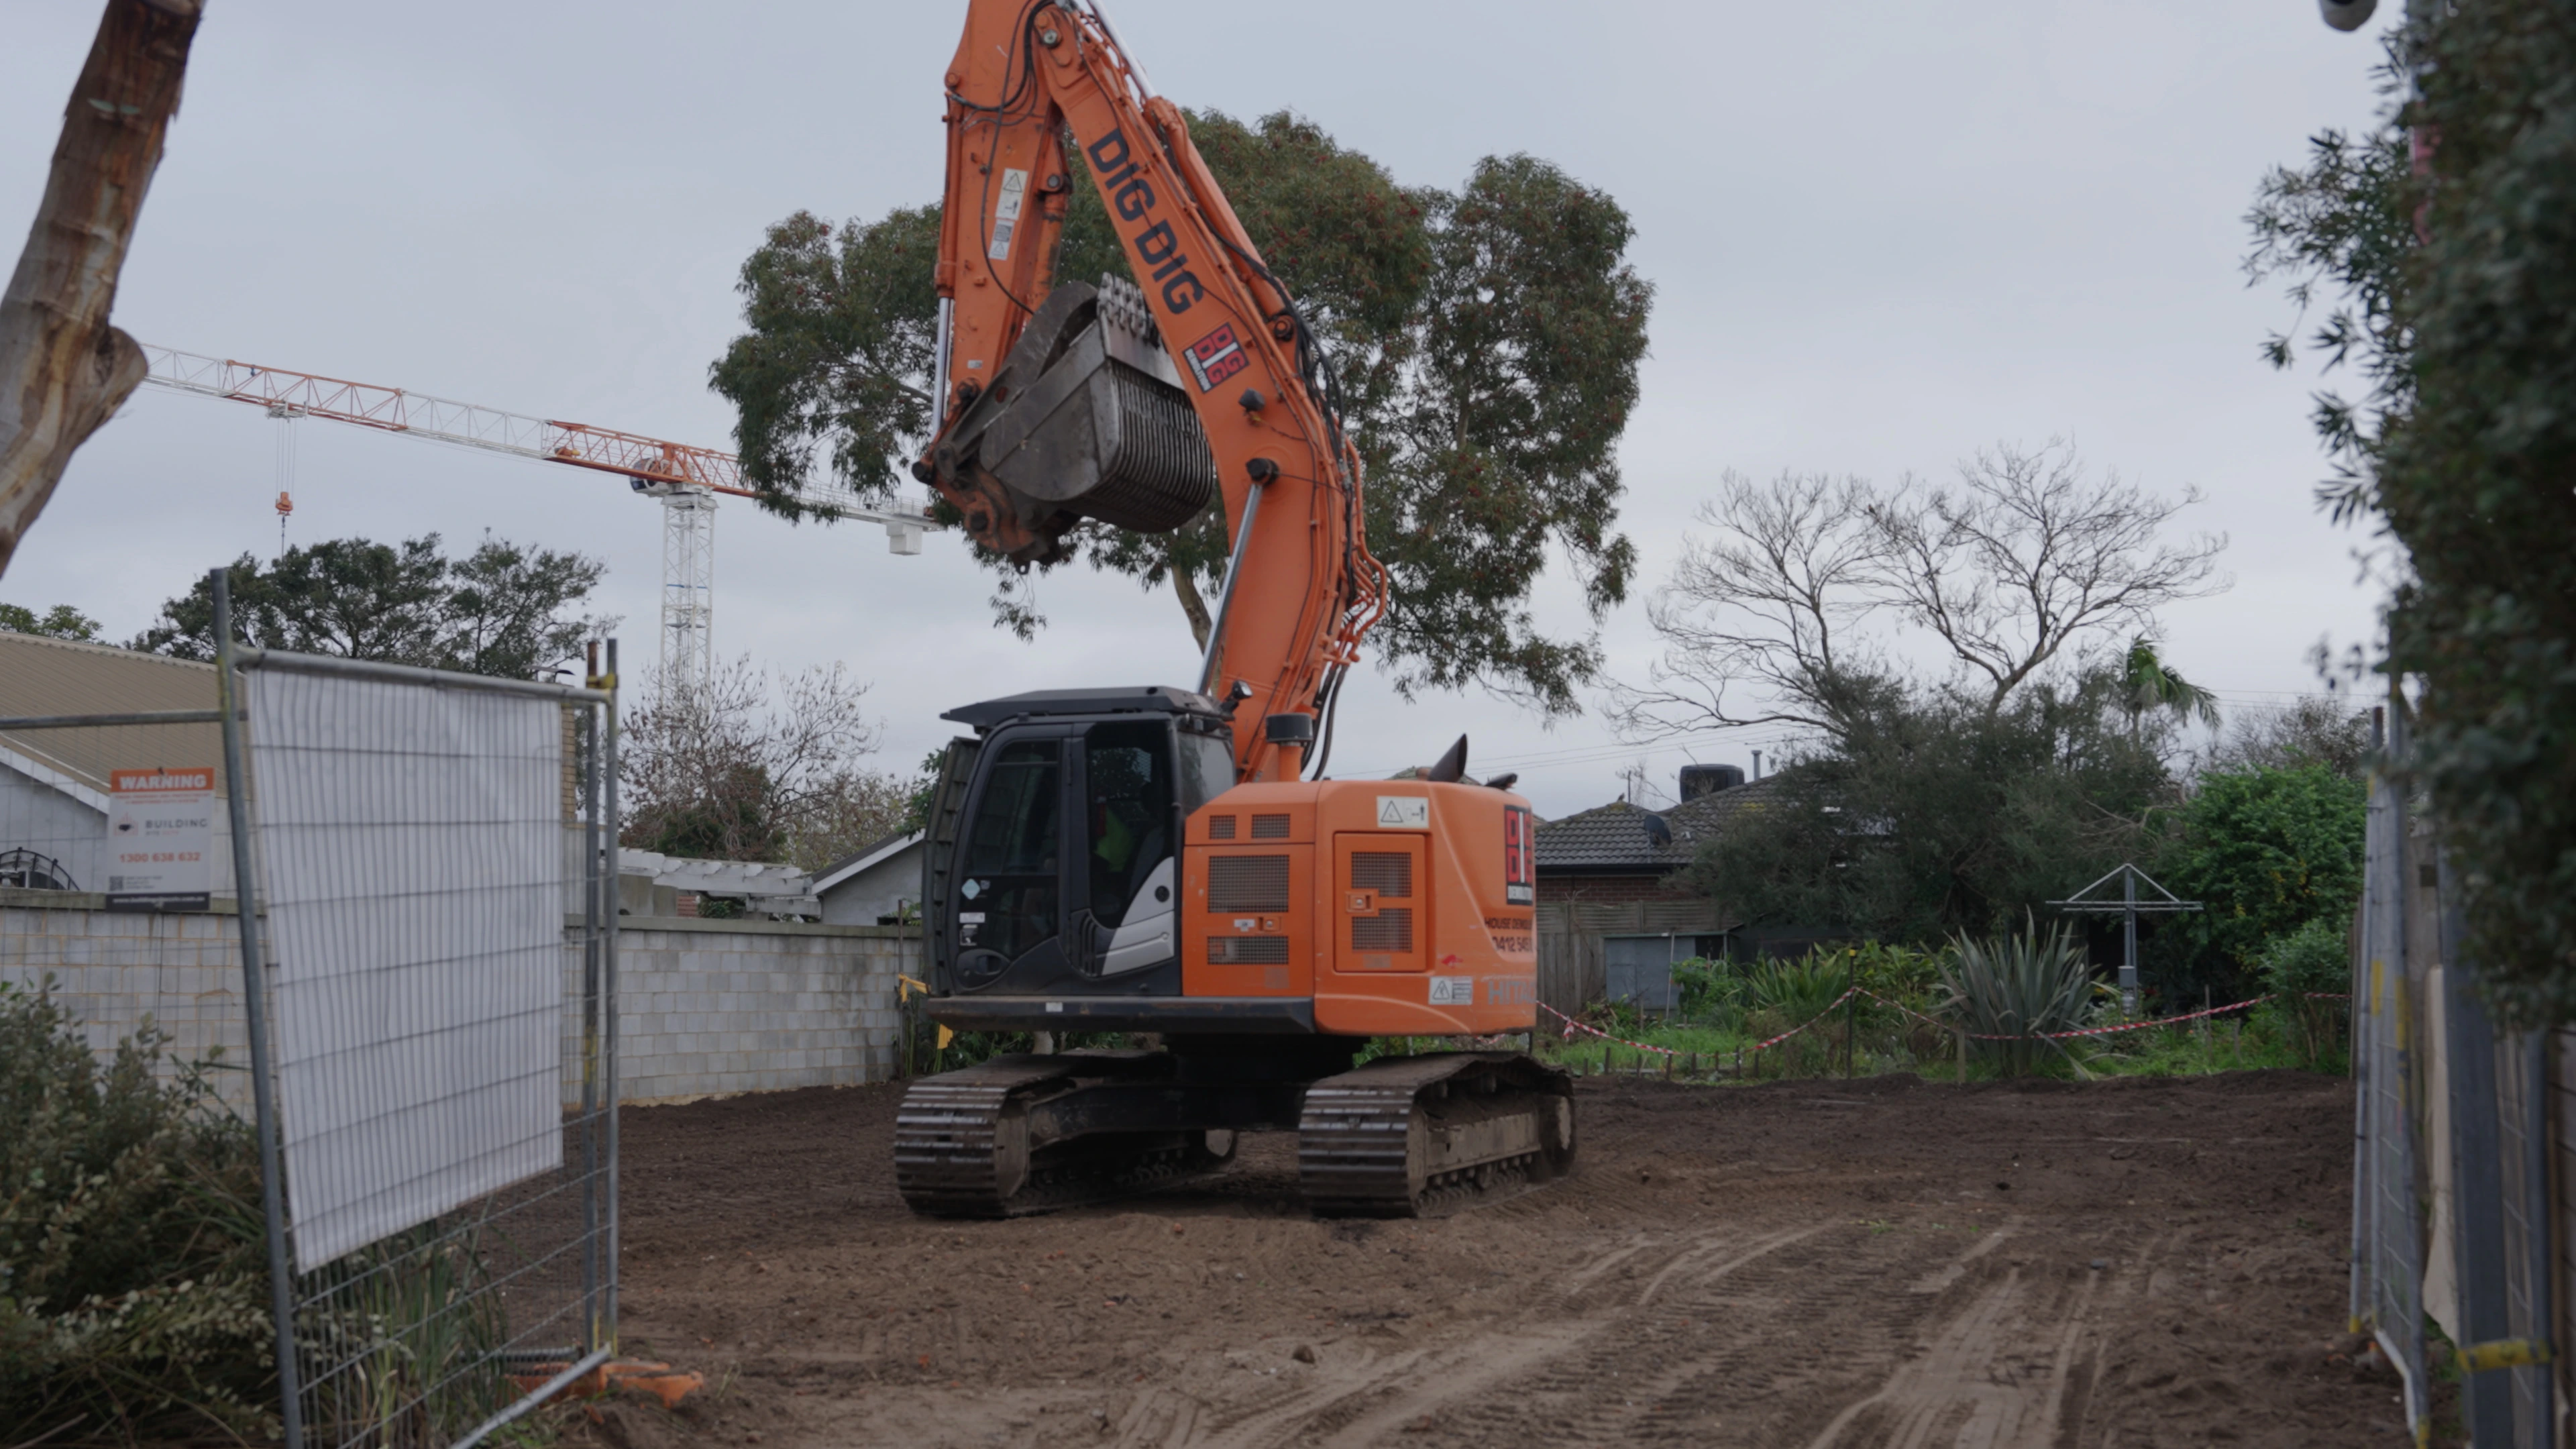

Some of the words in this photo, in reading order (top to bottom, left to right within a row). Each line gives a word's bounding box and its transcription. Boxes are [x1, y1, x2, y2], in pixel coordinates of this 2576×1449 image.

[1088, 128, 1155, 222] DIG
[1134, 219, 1204, 315] DIG
[119, 773, 207, 790] WARNING
[146, 818, 208, 829] BUILDING
